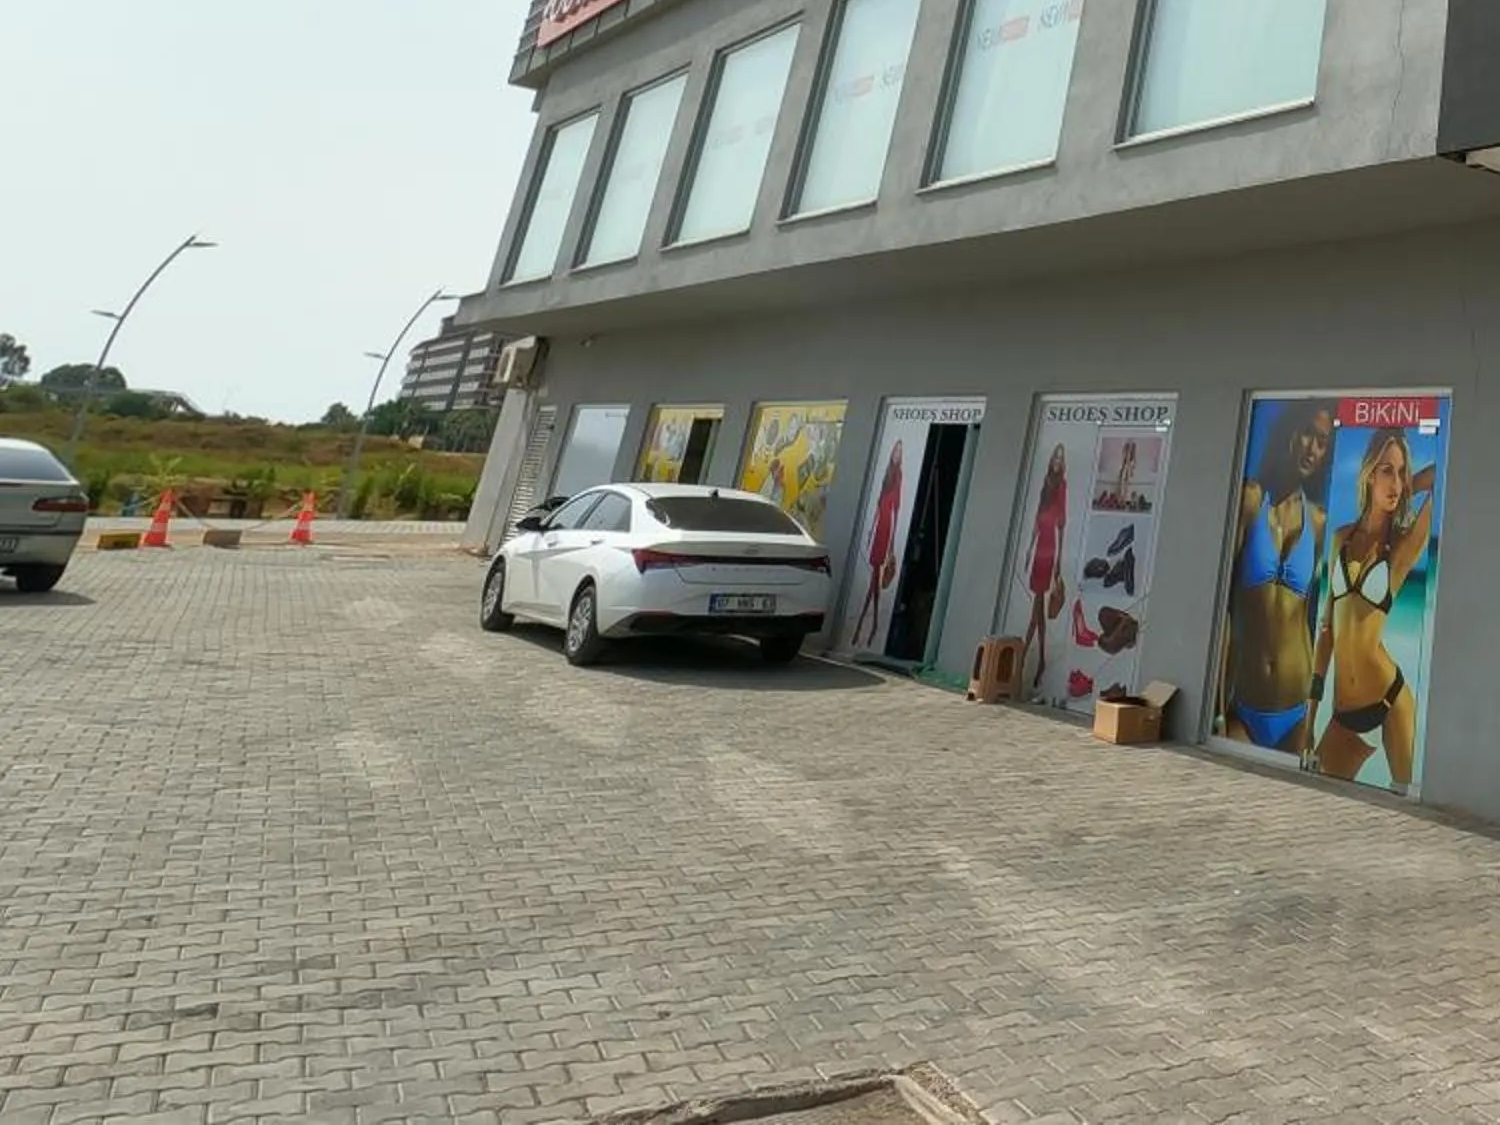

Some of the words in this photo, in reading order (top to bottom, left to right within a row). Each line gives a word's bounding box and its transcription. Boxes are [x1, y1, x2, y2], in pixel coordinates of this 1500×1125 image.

[893, 408, 938, 420] SHOES
[939, 408, 983, 421] SHOP
[1047, 406, 1108, 422] SHOES
[1112, 406, 1169, 422] SHOP
